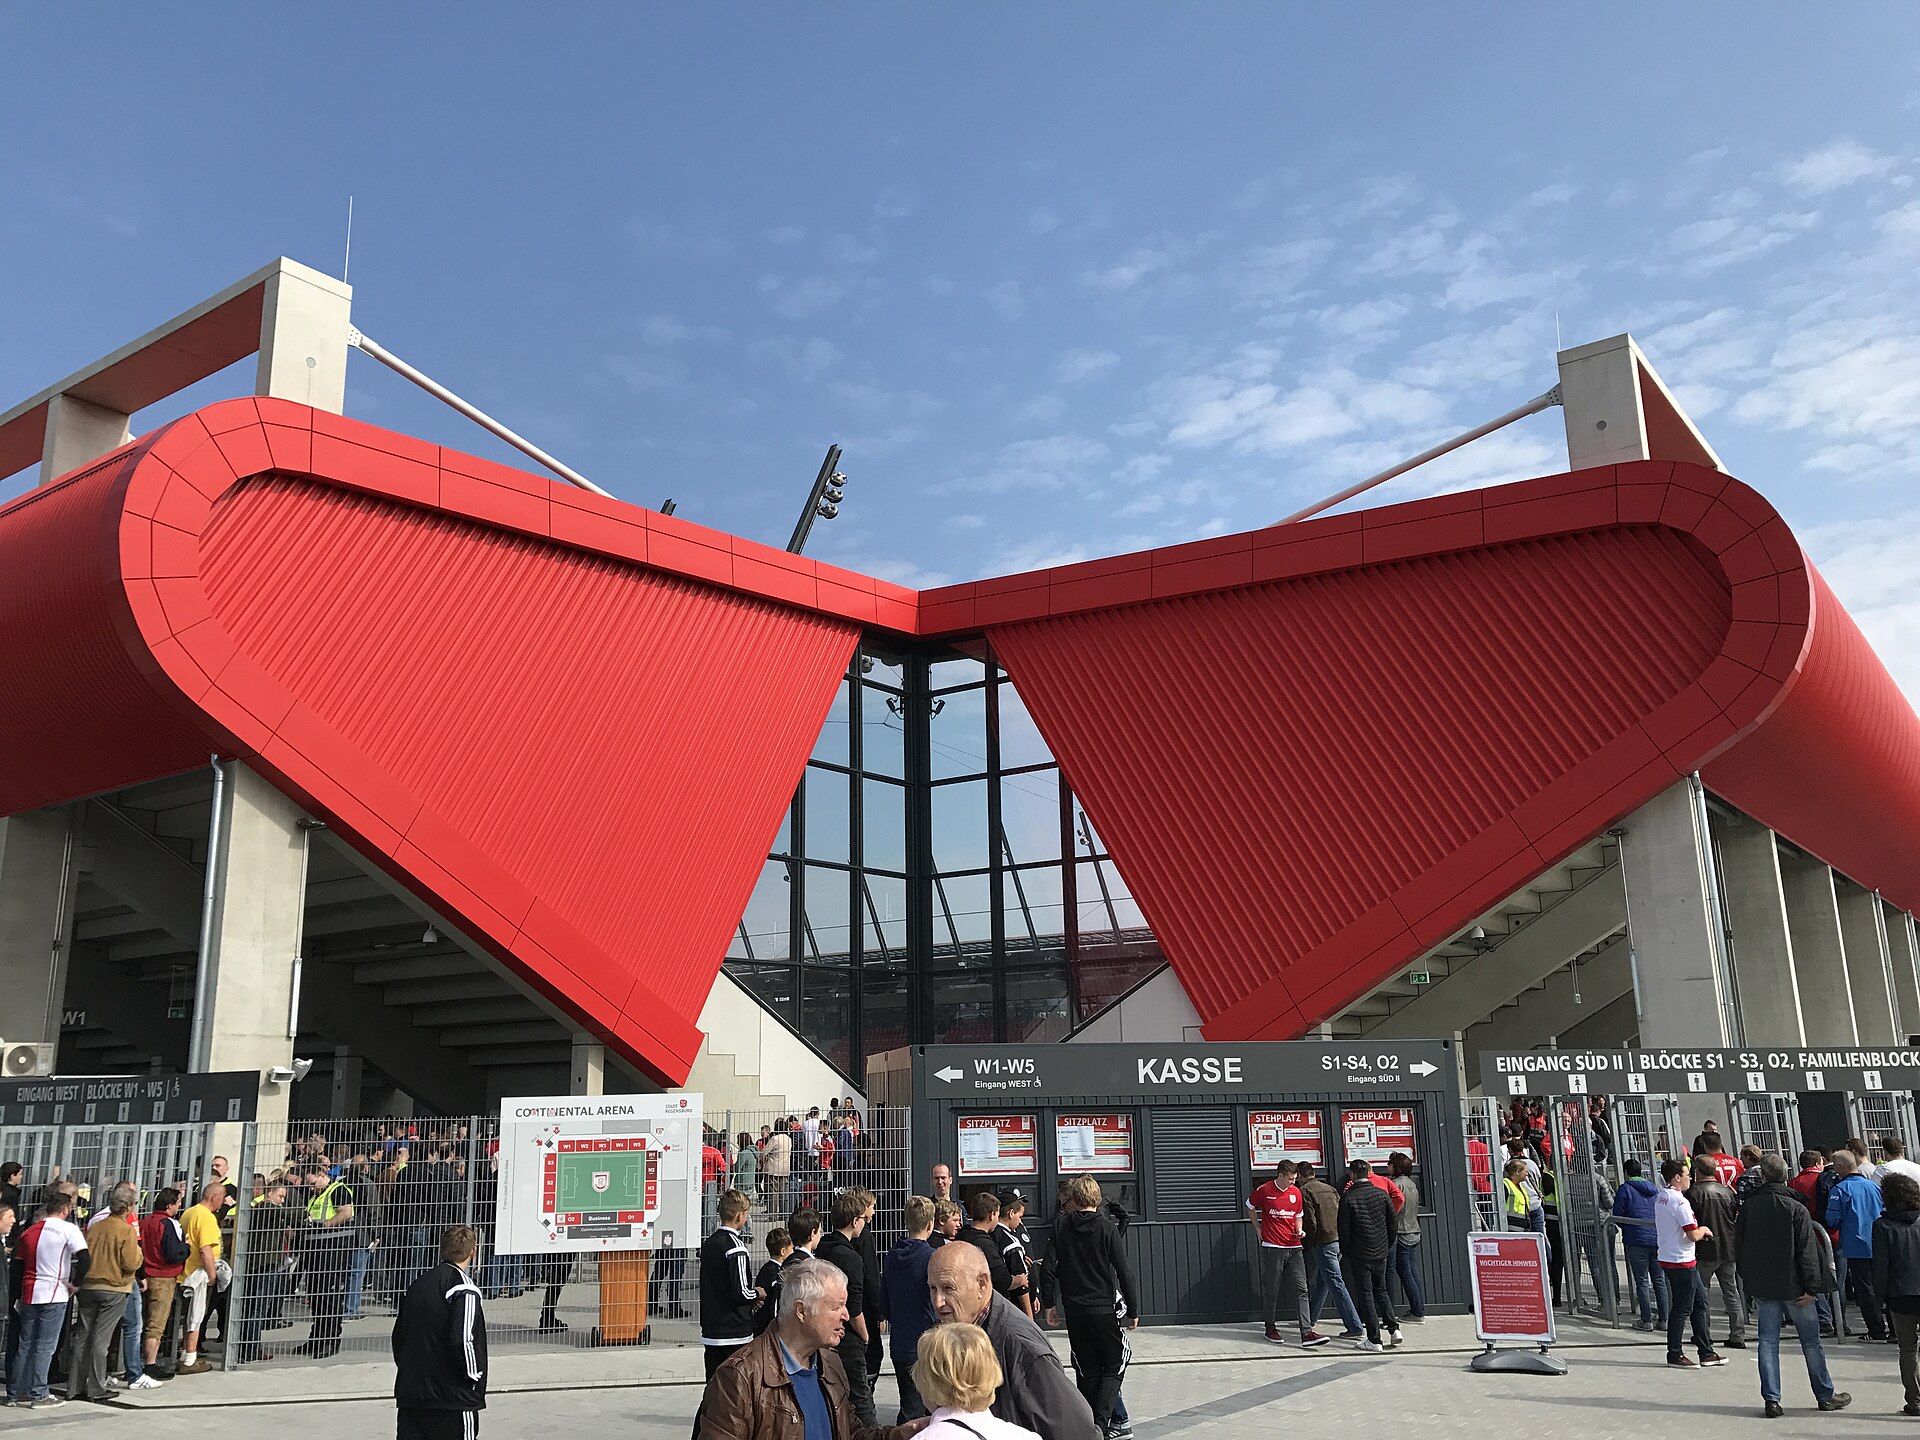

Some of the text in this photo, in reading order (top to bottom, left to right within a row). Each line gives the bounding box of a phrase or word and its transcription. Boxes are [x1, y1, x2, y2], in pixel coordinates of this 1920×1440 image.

[974, 1058, 1035, 1074] W1-W5
[1321, 1055, 1372, 1072] S1-S4,
[1496, 1055, 1571, 1073] EINGANG
[1576, 1051, 1609, 1071] SÜD
[1613, 1054, 1624, 1070] II
[1639, 1050, 1703, 1070] BLÖCKE
[1706, 1053, 1724, 1069] S1
[1740, 1053, 1764, 1071] S3,
[1798, 1051, 1920, 1068] FAMILIENBLOCK
[1137, 1057, 1243, 1084] KASSE
[1347, 1075, 1377, 1084] Eingang
[1378, 1073, 1394, 1082] SÜD
[974, 1079, 1032, 1090] Eingang WEST
[16, 1085, 54, 1102] EINGANG
[55, 1085, 79, 1101] WEST
[86, 1079, 123, 1100] BLÖCKE
[124, 1082, 139, 1099] W1
[147, 1081, 164, 1098] W5
[596, 1105, 635, 1116] ARENA
[1348, 1111, 1393, 1121] STEHPLATZ
[966, 1119, 1011, 1128] SITZPLATZ
[1063, 1117, 1108, 1126] SITZPLATZ
[1255, 1114, 1302, 1123] STEHPLATZ
